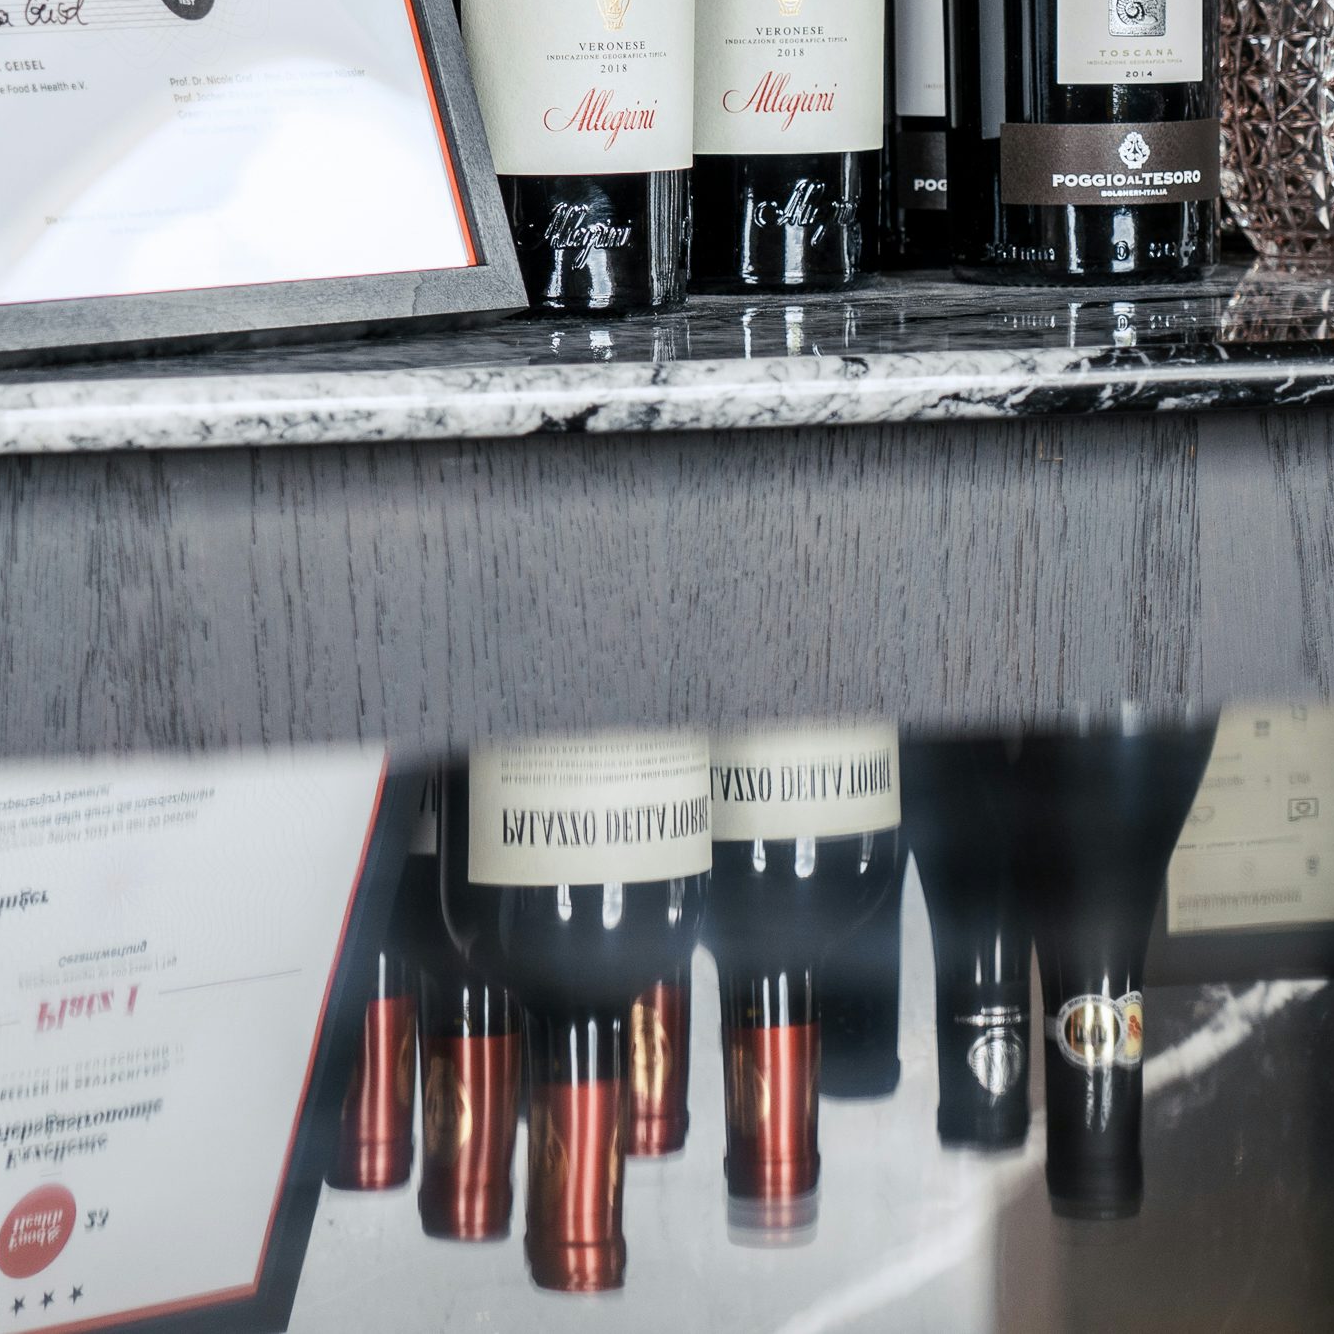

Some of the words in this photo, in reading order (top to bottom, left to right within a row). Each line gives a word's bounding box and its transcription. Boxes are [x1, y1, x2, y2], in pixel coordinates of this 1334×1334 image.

[755, 27, 824, 36] VERONESE
[578, 41, 646, 51] VERONESE
[777, 48, 805, 57] 2018
[1099, 49, 1173, 57] TOSCANA
[5, 60, 45, 72] GEISEL
[600, 64, 627, 73] 2018
[7, 83, 29, 94] Food
[32, 84, 37, 92] &
[41, 82, 69, 92] Health
[722, 71, 837, 131] Allegrini
[543, 87, 658, 152] Allegrini
[914, 179, 947, 192] POG
